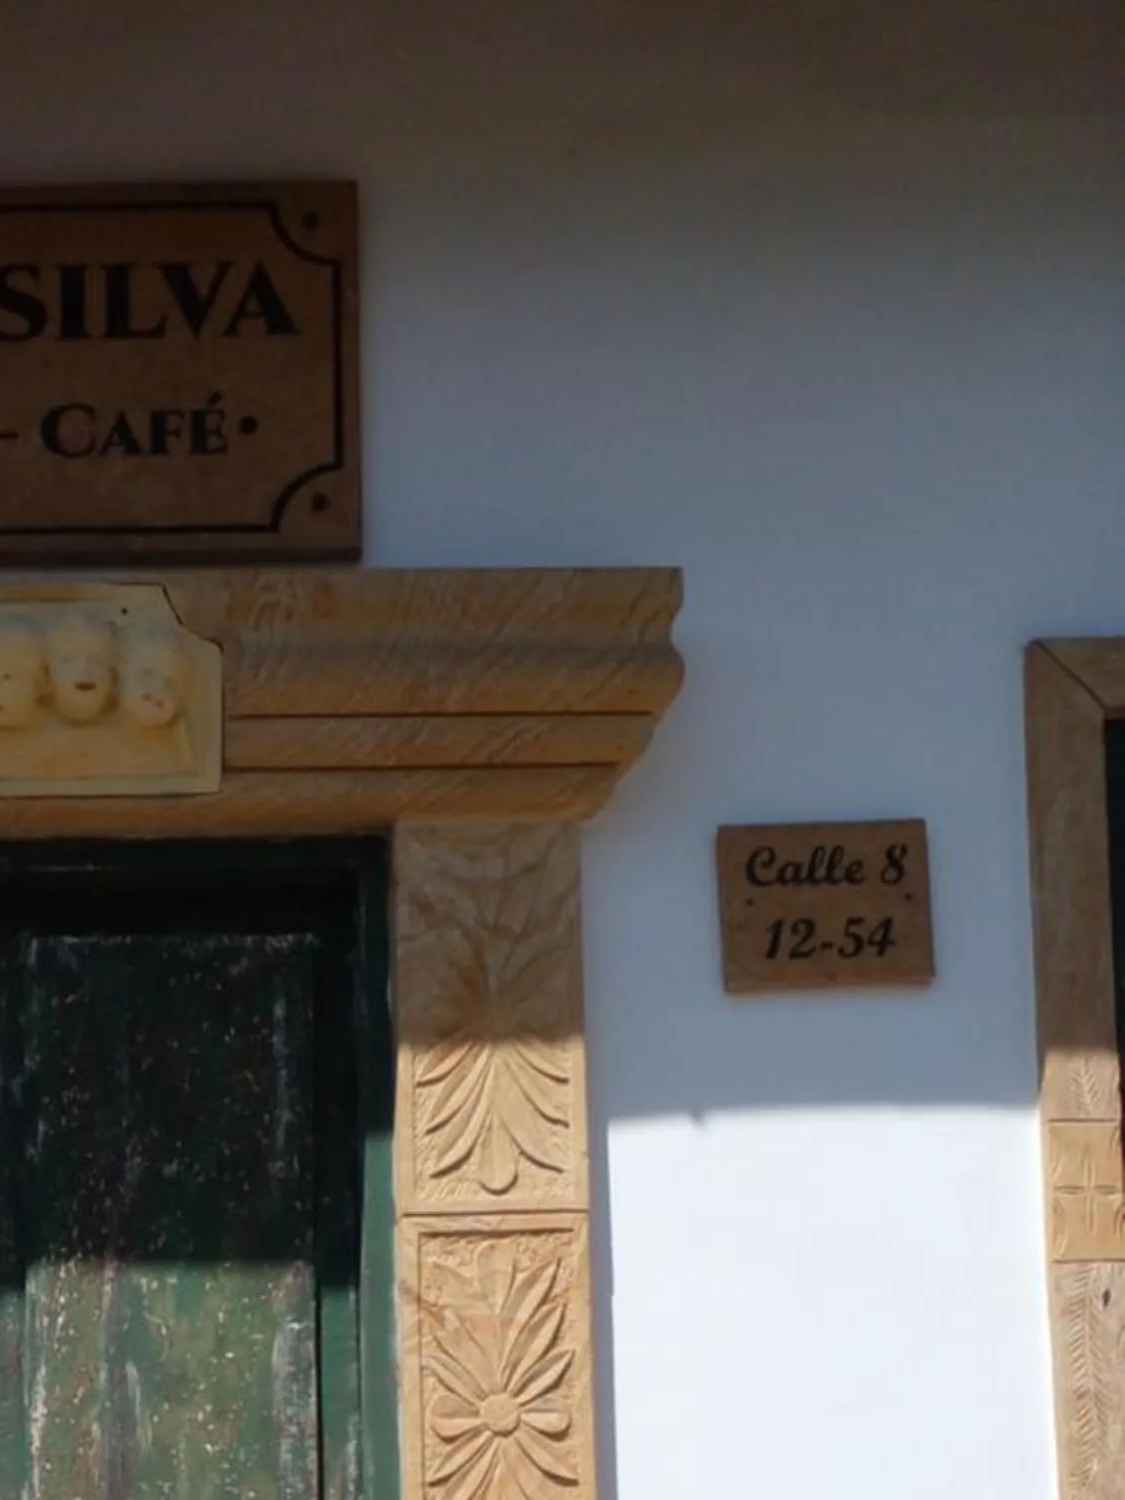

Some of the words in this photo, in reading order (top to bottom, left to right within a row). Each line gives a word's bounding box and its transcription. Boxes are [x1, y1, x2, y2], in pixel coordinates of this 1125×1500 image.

[745, 845, 866, 887] Calle
[880, 844, 908, 884] 8
[765, 916, 896, 960] 12-54
